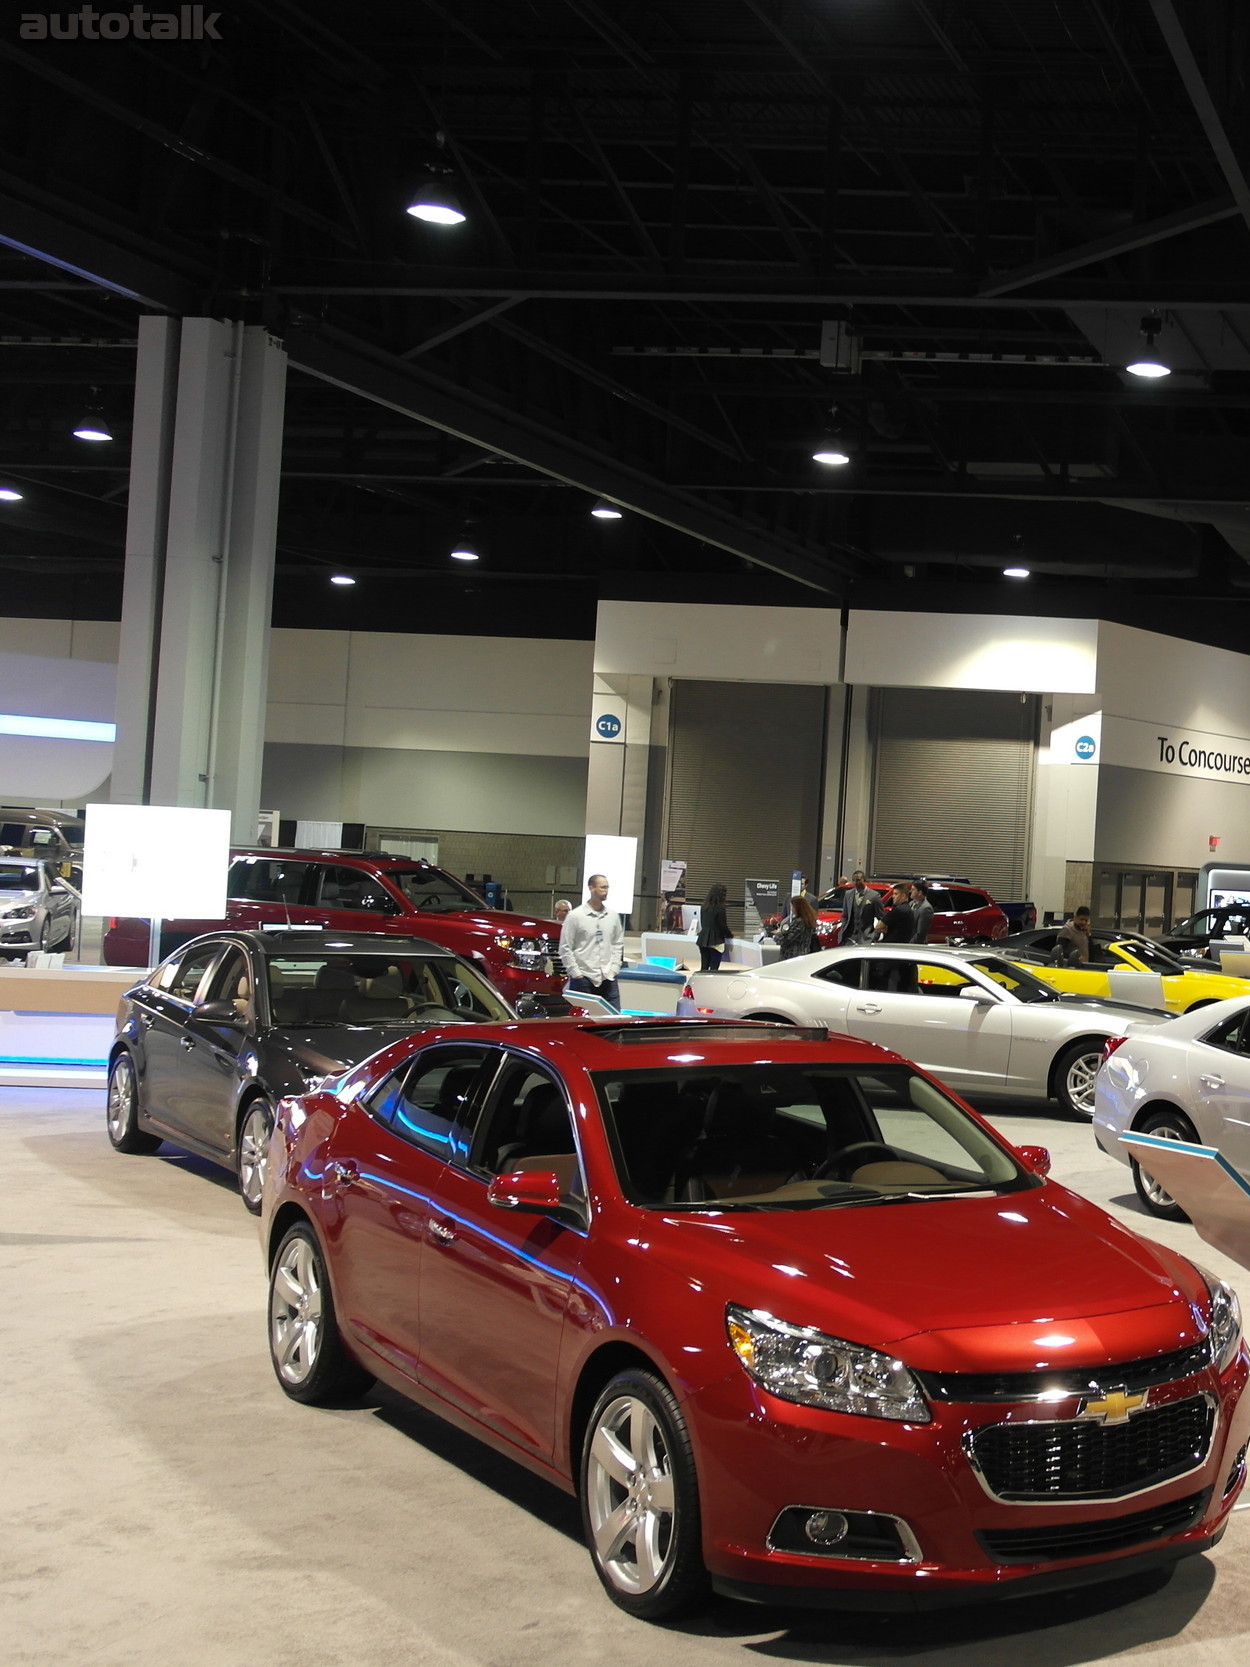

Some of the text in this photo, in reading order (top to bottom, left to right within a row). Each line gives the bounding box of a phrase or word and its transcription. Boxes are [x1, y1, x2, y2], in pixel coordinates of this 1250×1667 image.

[598, 721, 618, 731] C1a
[1077, 742, 1094, 752] C2a
[1158, 737, 1250, 775] To Concourse
